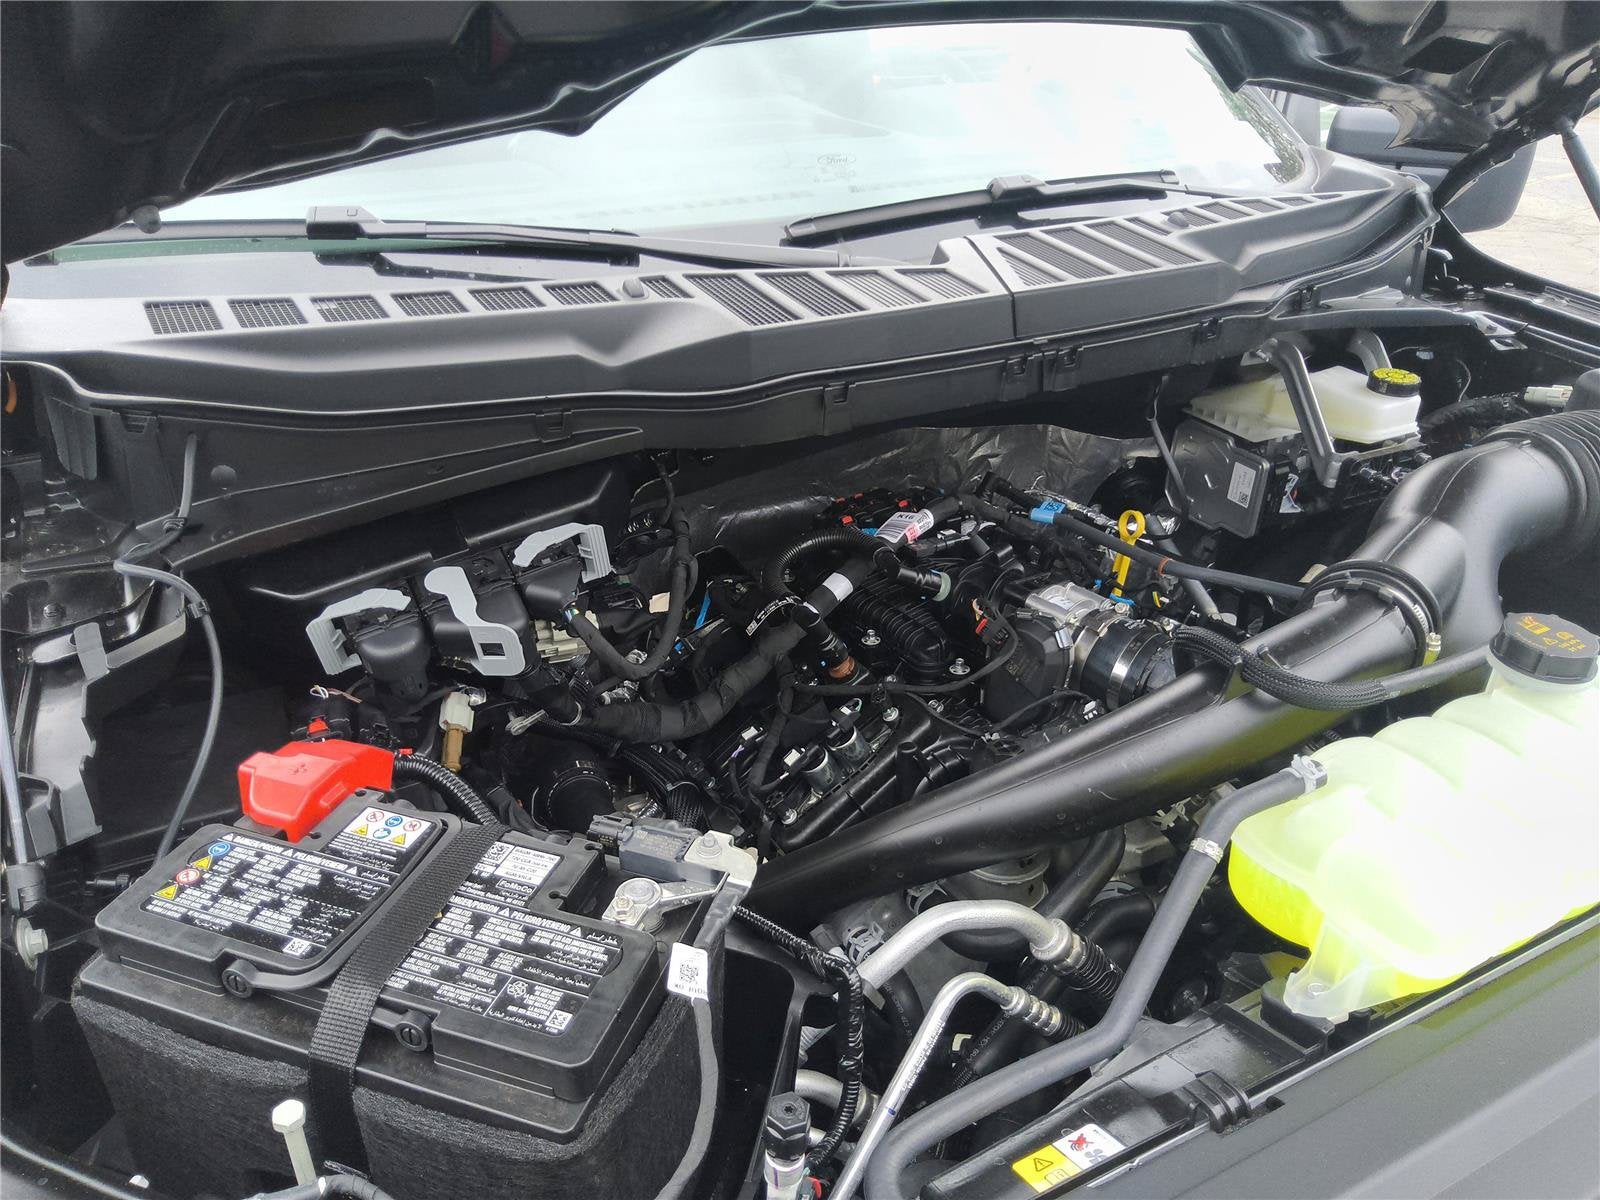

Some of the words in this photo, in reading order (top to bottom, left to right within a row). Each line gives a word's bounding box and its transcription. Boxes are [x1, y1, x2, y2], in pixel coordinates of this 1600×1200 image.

[499, 880, 533, 893] FoMoCo
[449, 894, 500, 913] ANGER/POISON
[510, 910, 571, 932] PELIGRO/VENENO
